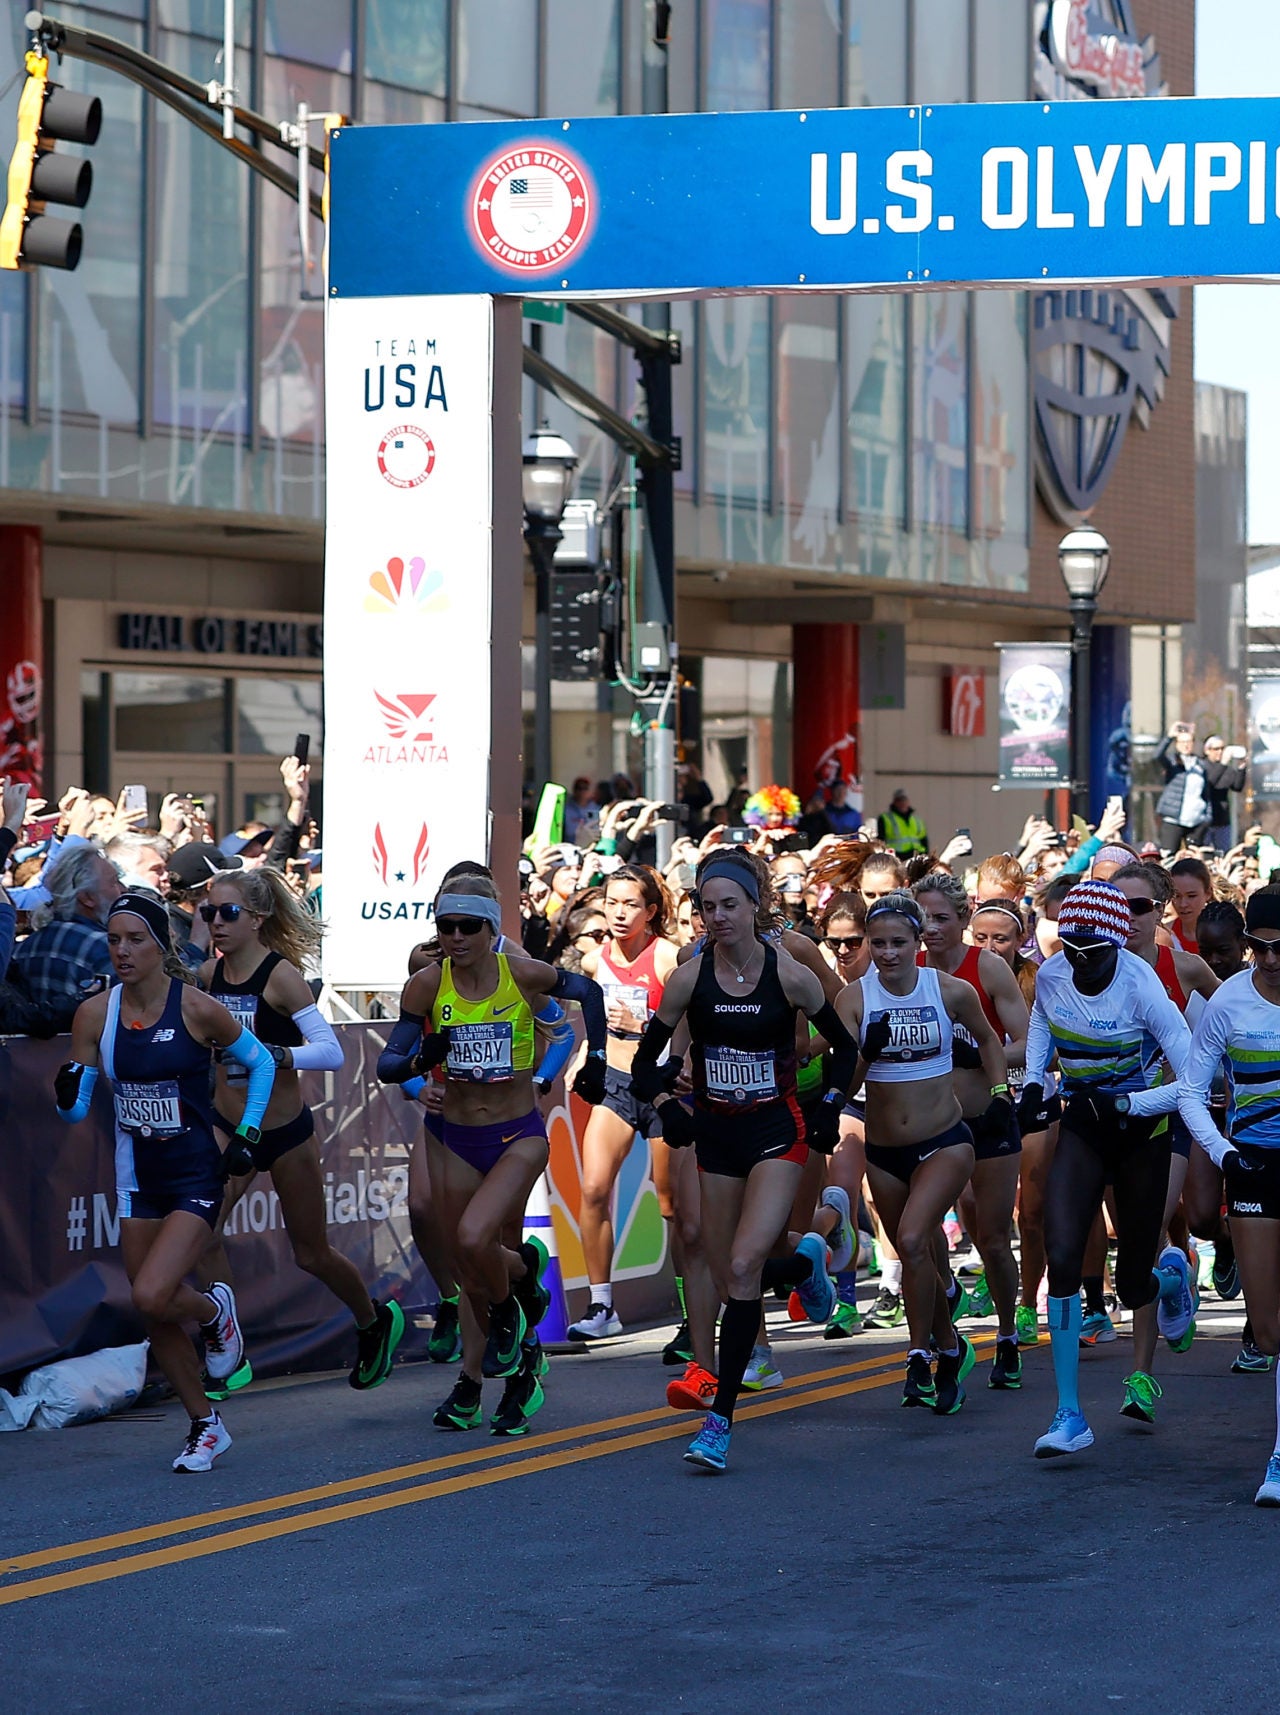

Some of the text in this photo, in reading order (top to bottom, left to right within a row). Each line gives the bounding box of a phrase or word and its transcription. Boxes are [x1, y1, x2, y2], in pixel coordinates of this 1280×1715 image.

[488, 152, 576, 185] UNITED STATES
[811, 150, 953, 234] U.S.
[488, 232, 575, 265] OLYMPIC TEAM
[375, 338, 436, 357] TEAM
[365, 364, 448, 412] USA
[122, 613, 190, 652] HALL
[363, 745, 449, 764] ATLANTA
[442, 1004, 452, 1021] 8
[714, 1004, 761, 1014] saucony
[468, 1025, 495, 1033] OLYMPIC
[888, 1016, 903, 1024] EAM
[1089, 1019, 1118, 1030] HOKA
[457, 1032, 495, 1041] TEAM TRIALS
[452, 1040, 504, 1063] HASAY
[709, 1061, 770, 1085] HUDDLE
[134, 1083, 160, 1092] OLYMPIC
[121, 1099, 173, 1122] SISSON
[1233, 1200, 1262, 1213] HOKA
